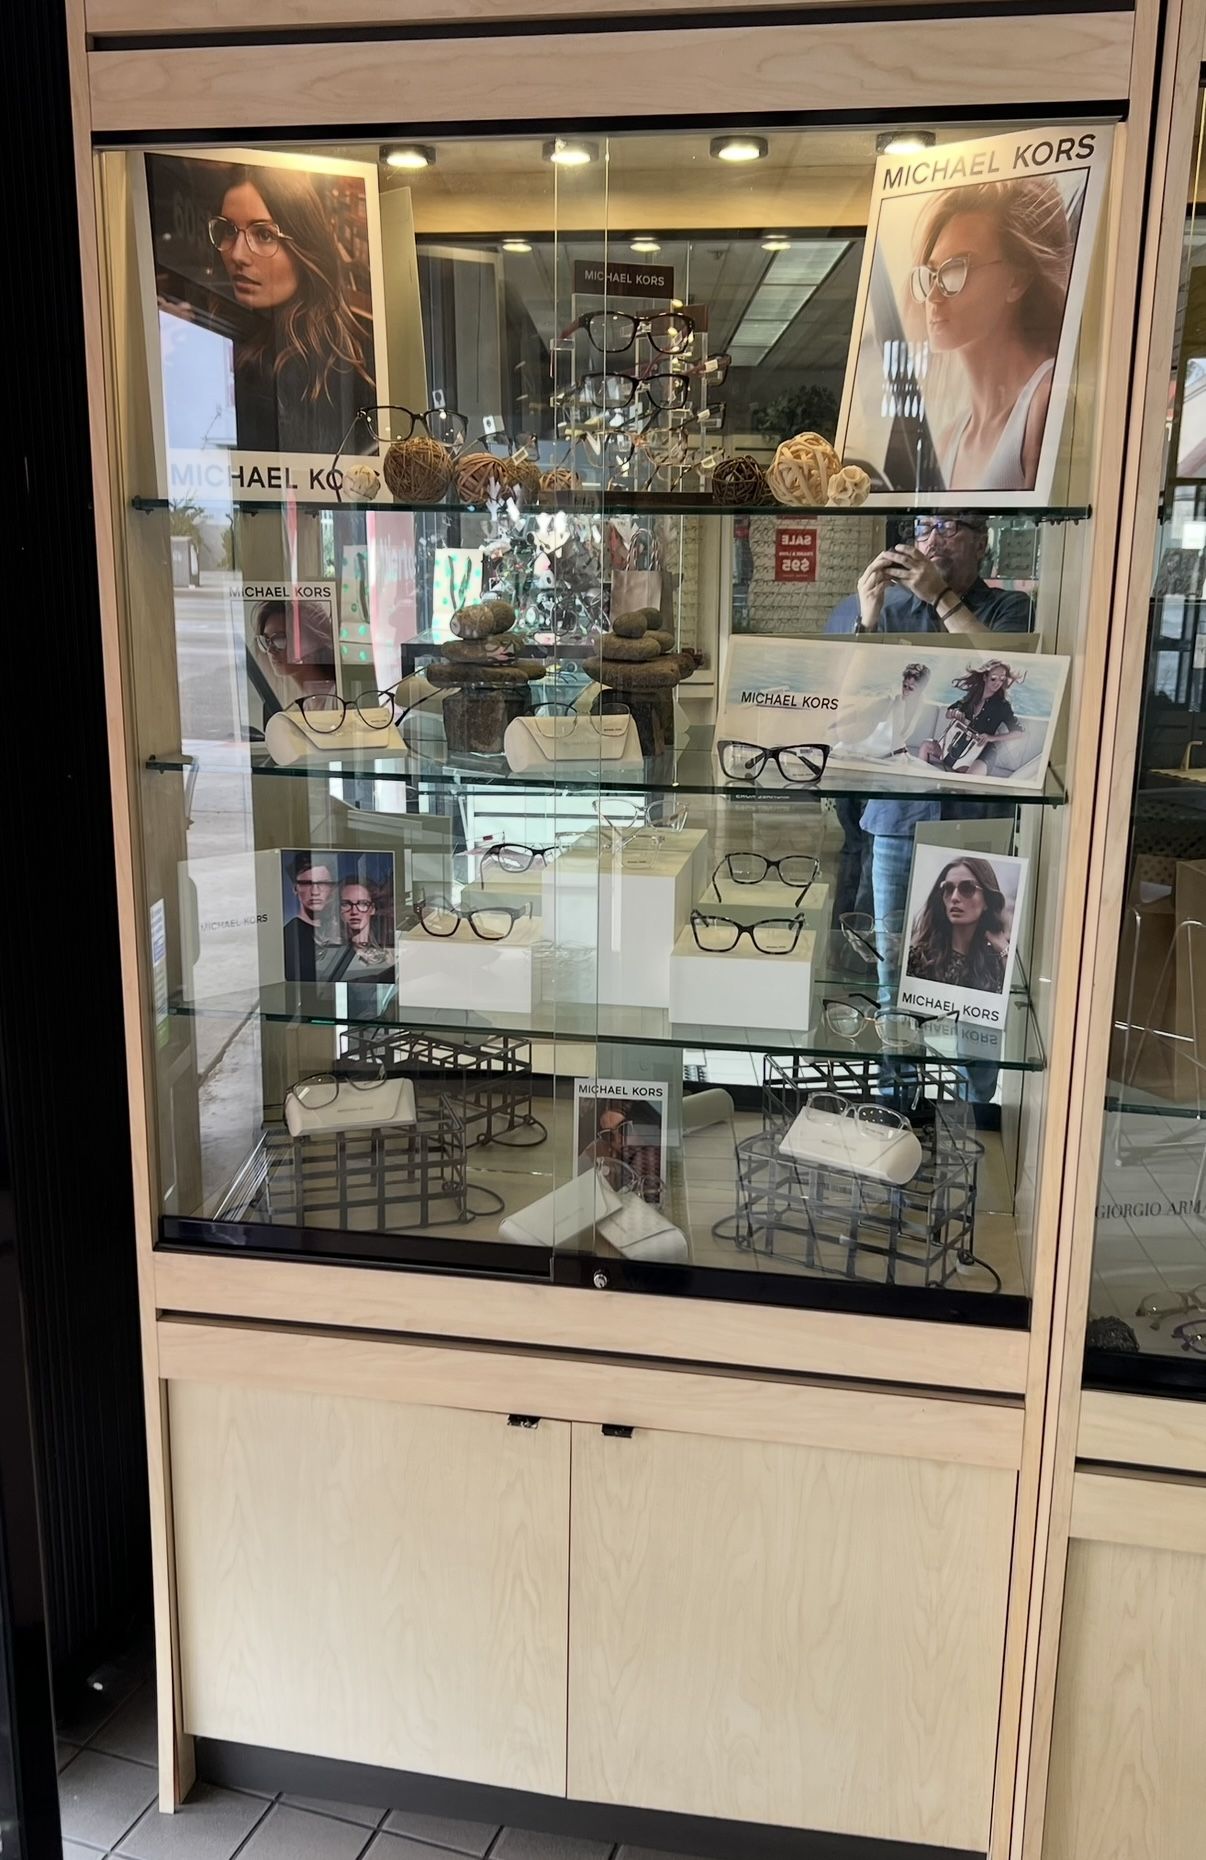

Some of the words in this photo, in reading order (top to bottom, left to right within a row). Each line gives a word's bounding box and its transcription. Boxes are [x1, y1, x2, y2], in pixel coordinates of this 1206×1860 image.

[882, 150, 1000, 191] MICHAEL
[1013, 133, 1096, 170] KORS
[584, 270, 632, 284] MICHAEL
[635, 274, 665, 287] KORS
[171, 463, 298, 489] MICHAEL
[229, 586, 290, 598] MICHAEL
[294, 586, 331, 598] KORS
[741, 691, 797, 707] MICHAEL
[802, 696, 839, 710] KORS
[902, 992, 957, 1012] MICHAEL
[963, 1004, 1000, 1022] KORS
[578, 1084, 628, 1095] MICHAEL
[632, 1086, 663, 1097] KORS
[1095, 1202, 1162, 1219] GIORGIO
[1167, 1199, 1206, 1216] ARM
